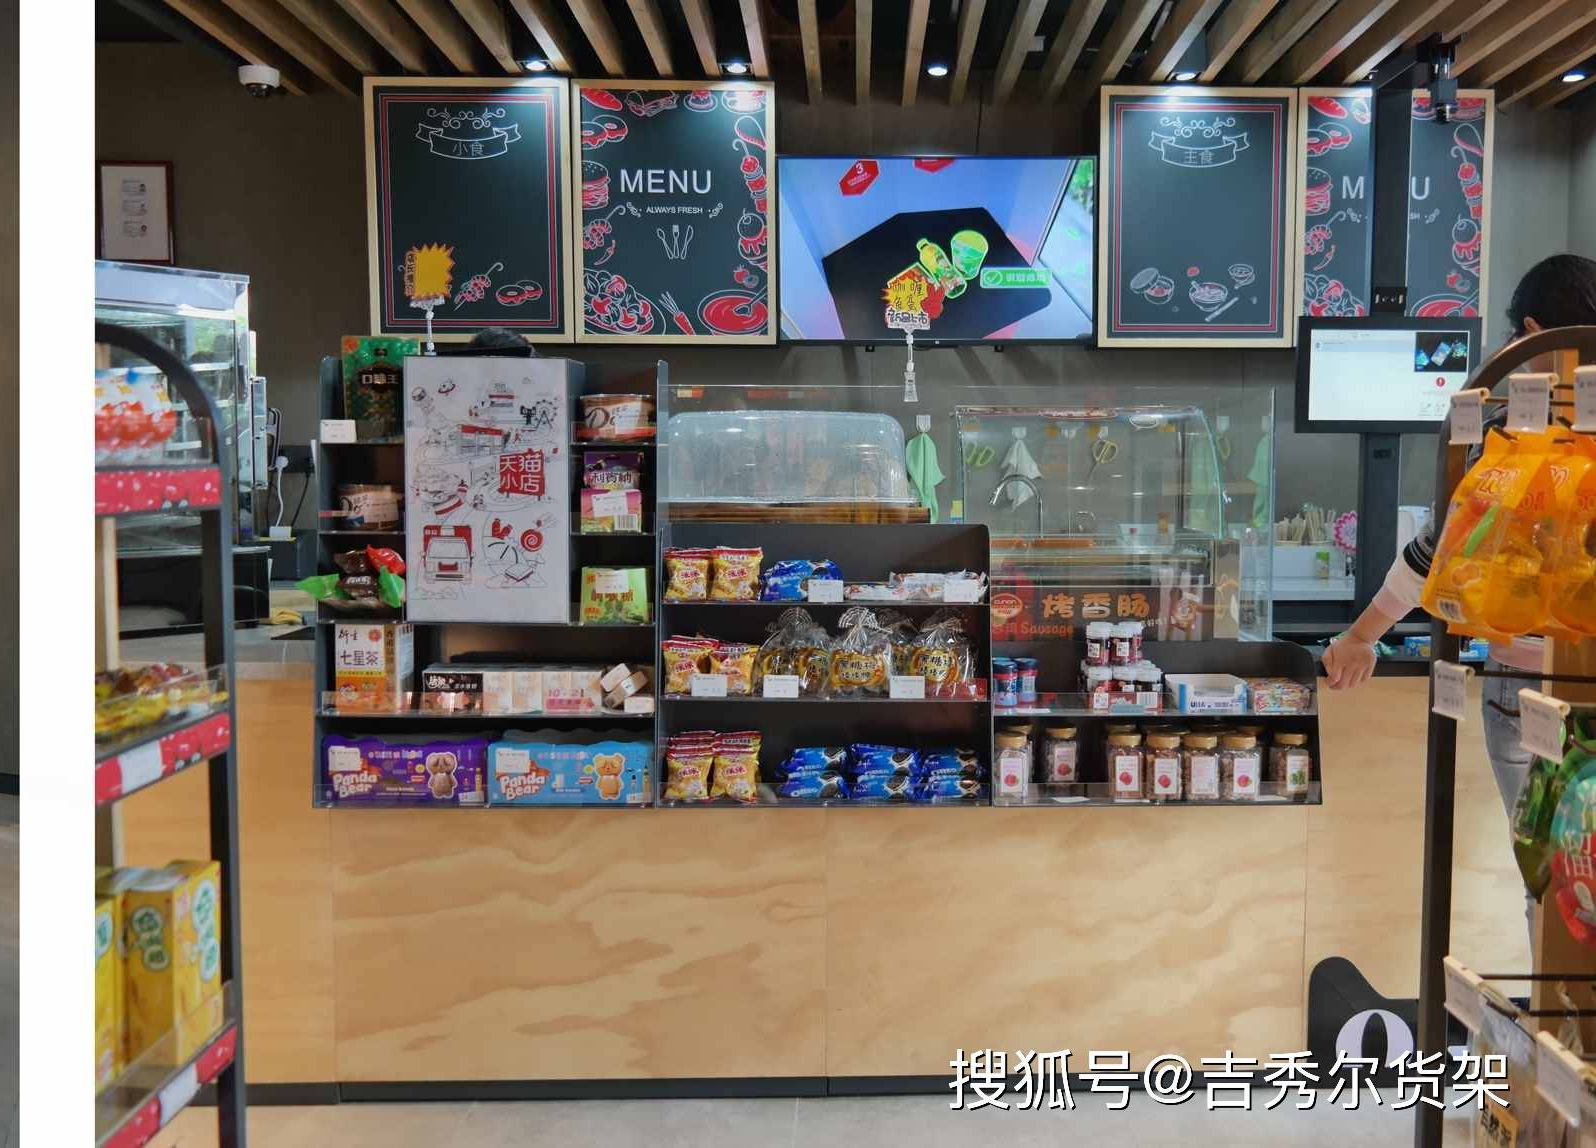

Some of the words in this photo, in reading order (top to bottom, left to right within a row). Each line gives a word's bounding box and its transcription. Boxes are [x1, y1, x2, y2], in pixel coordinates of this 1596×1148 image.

[452, 140, 485, 157] 小食
[1182, 150, 1214, 166] 主食
[620, 168, 712, 194] MENU
[645, 206, 676, 215] ALWAYS
[677, 206, 703, 215] FRESH
[500, 453, 542, 473] 天猫
[500, 472, 541, 493] 小店
[1042, 591, 1150, 620] 烤香肠
[339, 650, 381, 667] 七星茶
[334, 771, 378, 793] Panda
[339, 783, 373, 799] Bear
[499, 770, 547, 794] Panda
[505, 784, 541, 800] Bear
